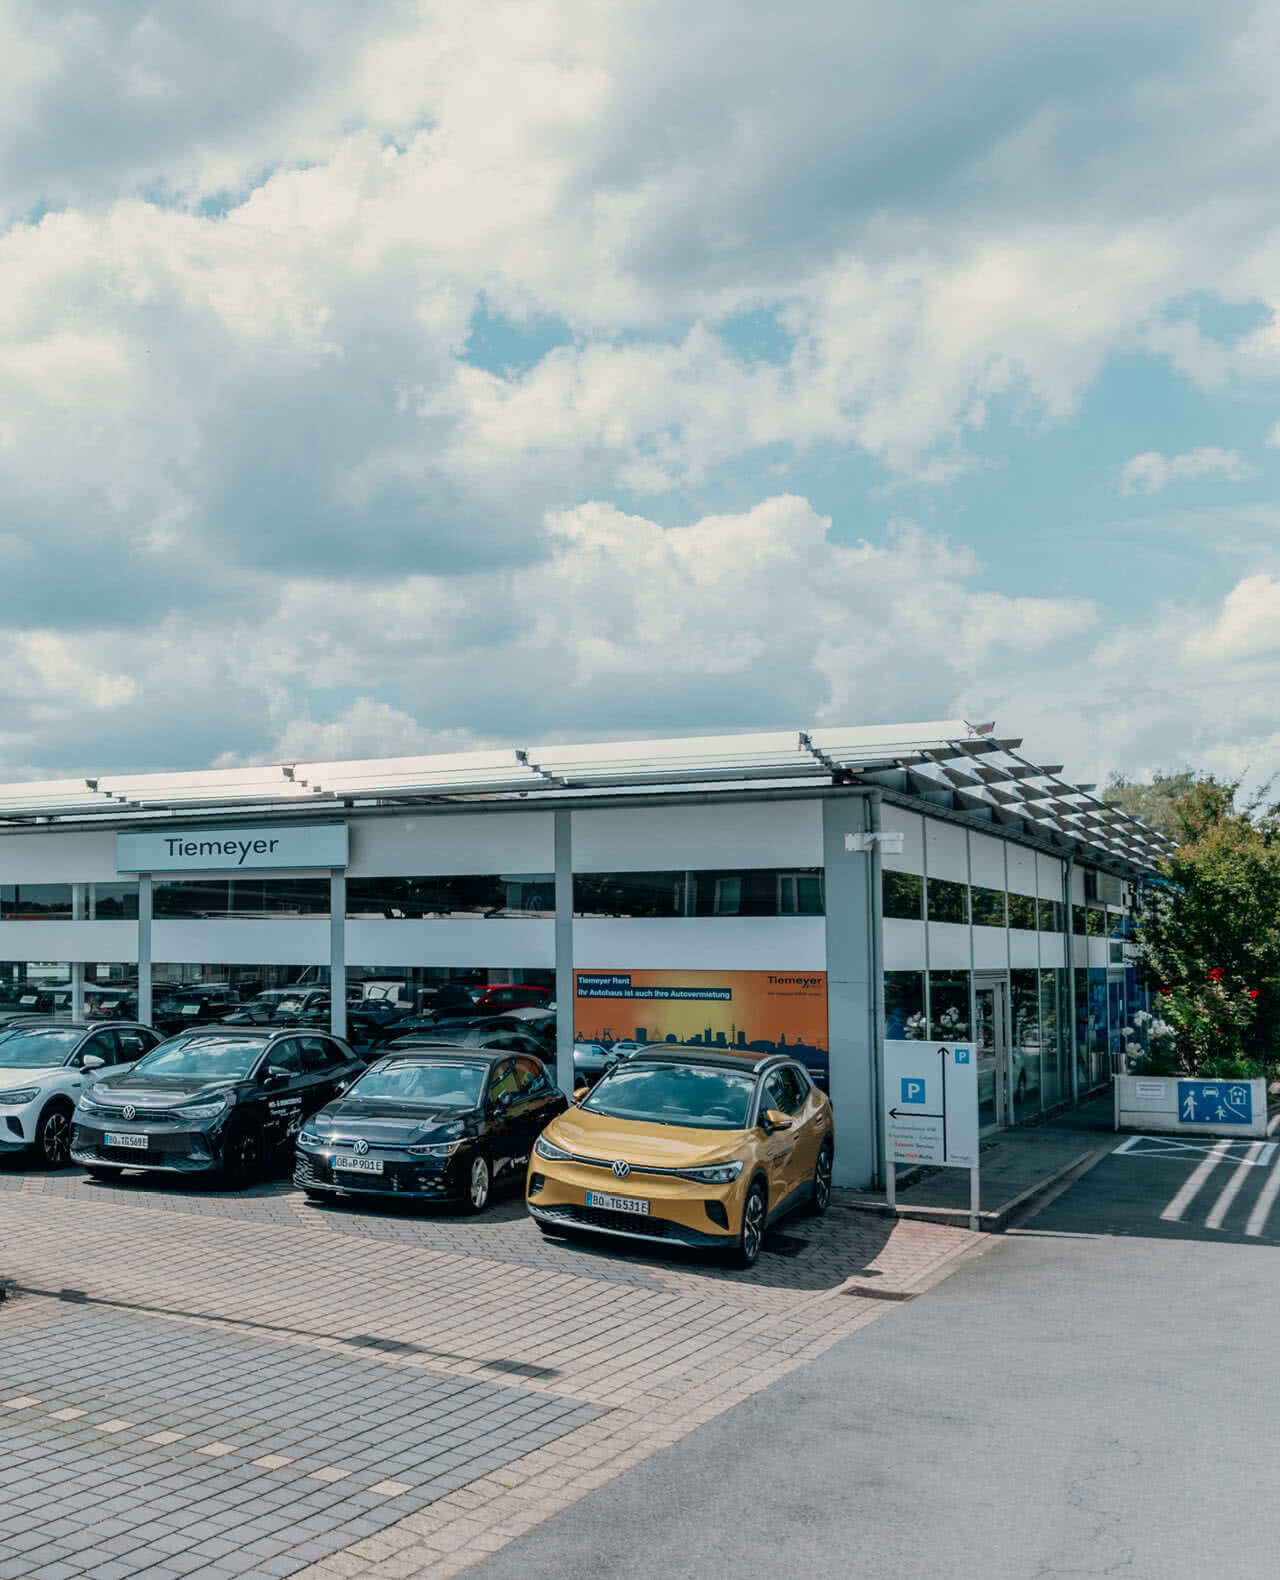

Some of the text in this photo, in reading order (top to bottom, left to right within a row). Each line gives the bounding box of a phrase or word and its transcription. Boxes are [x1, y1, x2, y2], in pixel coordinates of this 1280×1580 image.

[163, 838, 279, 865] Tiemeyer
[578, 976, 630, 985] Tiemeyer Rent
[767, 976, 822, 989] Tiemeyer
[578, 988, 730, 1000] Ihr Autohaus ist auch Ihre Autovermietung
[907, 1082, 921, 1099] P
[592, 1195, 605, 1206] BO
